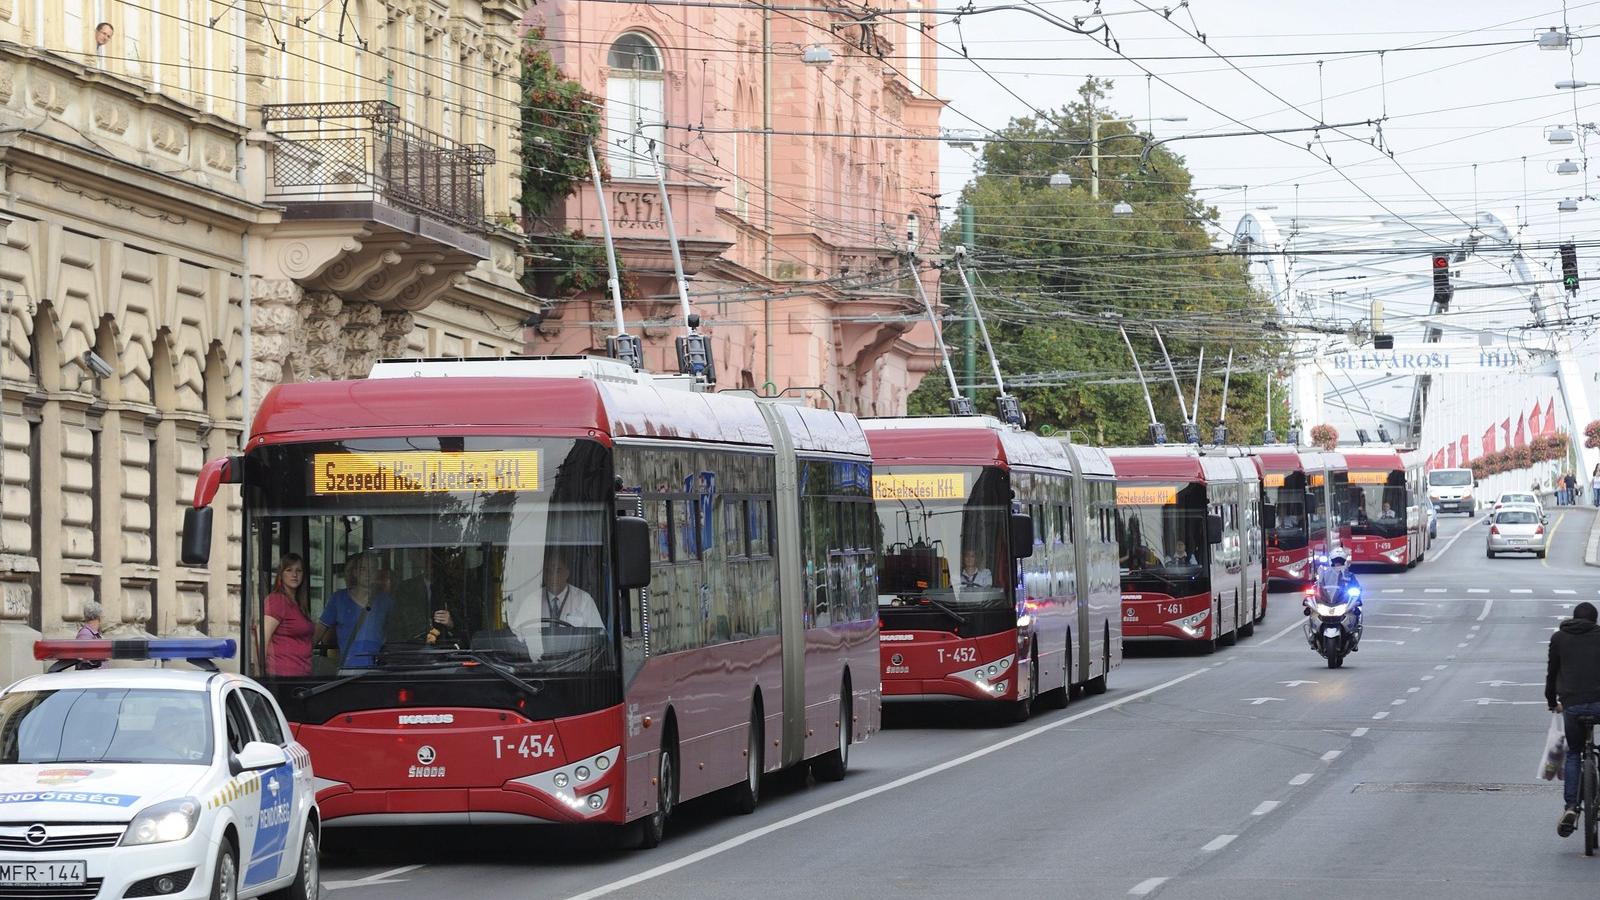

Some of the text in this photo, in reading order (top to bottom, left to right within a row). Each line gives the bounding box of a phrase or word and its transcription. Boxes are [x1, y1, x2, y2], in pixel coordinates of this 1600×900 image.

[326, 459, 526, 490] Szegedi Közlekedési Kft.
[875, 478, 956, 498] Közlekedési Kft.
[1157, 603, 1183, 614] T-461
[937, 647, 976, 664] T-452
[398, 714, 453, 725] IKARUS
[492, 734, 555, 759] T-454
[408, 765, 446, 778] ŠKODA
[0, 865, 79, 881] MFR-144
